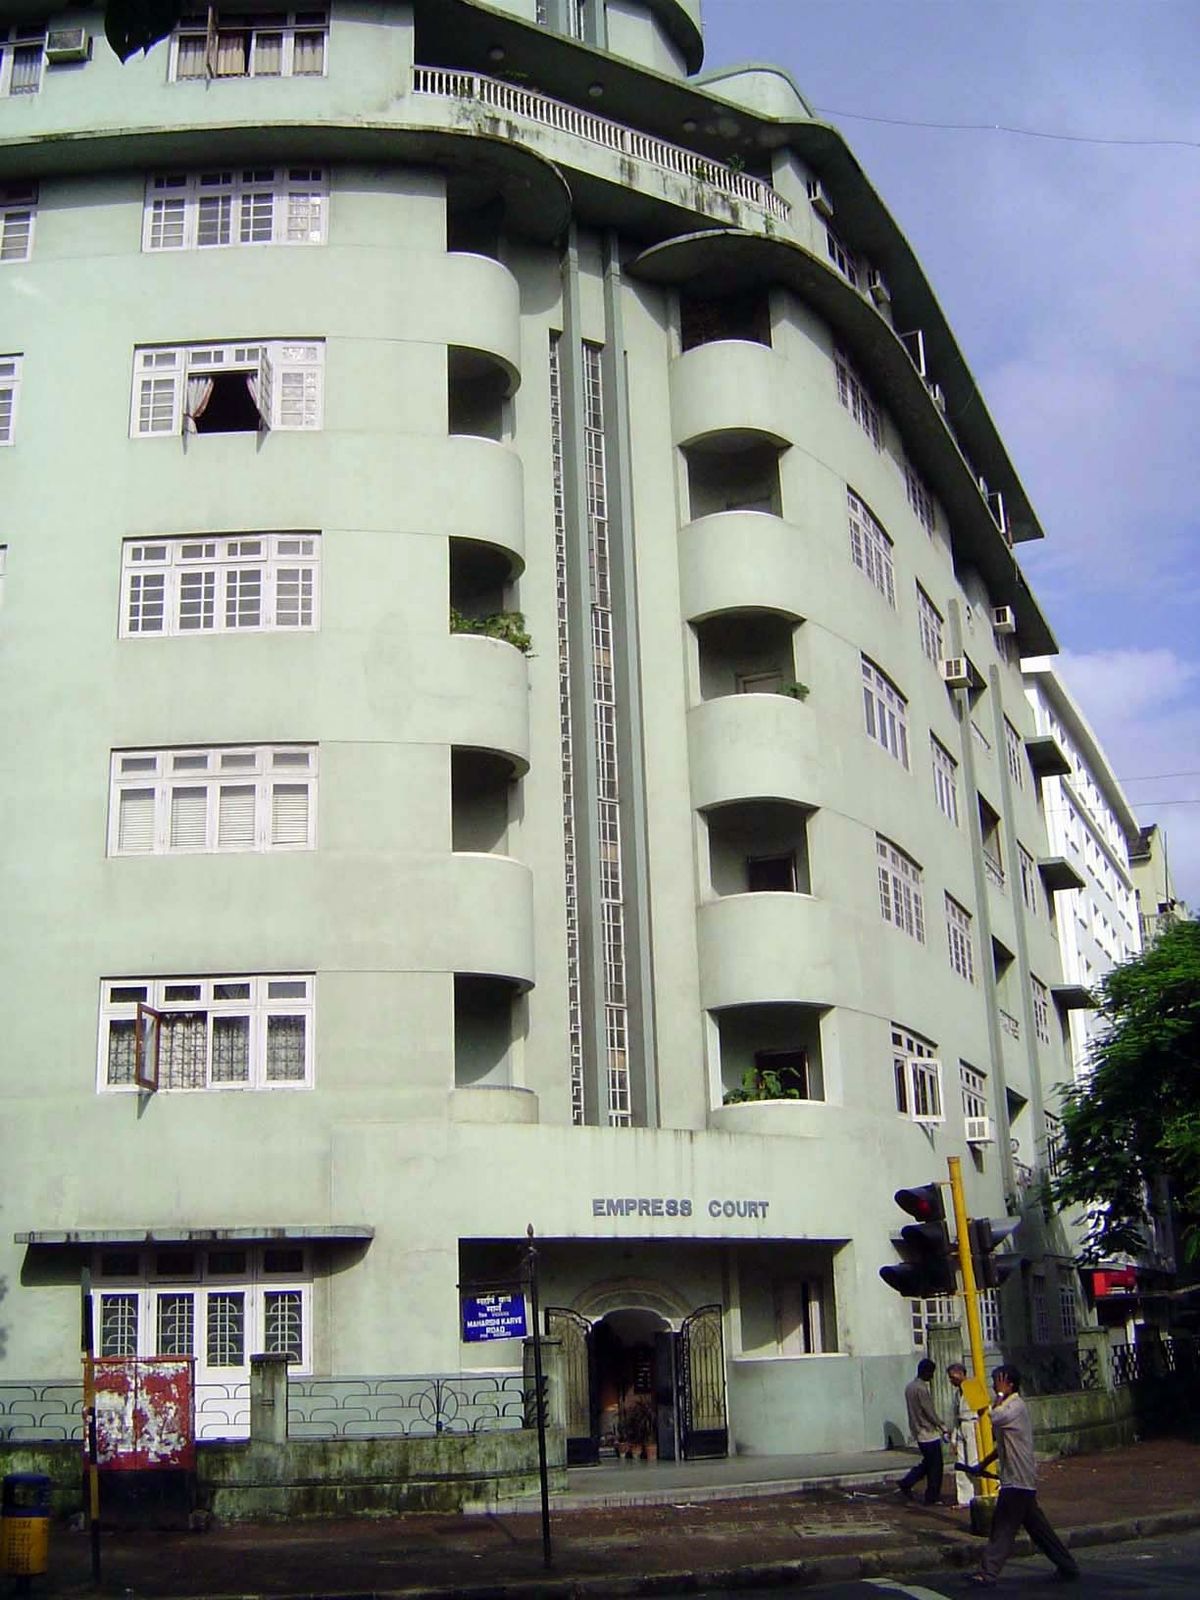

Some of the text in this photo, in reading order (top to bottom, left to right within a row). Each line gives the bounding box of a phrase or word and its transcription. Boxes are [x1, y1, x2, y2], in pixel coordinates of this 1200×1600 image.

[592, 1198, 769, 1218] EMPRESS COURT
[501, 1316, 523, 1326] KARVE
[486, 1326, 505, 1334] ROAD
